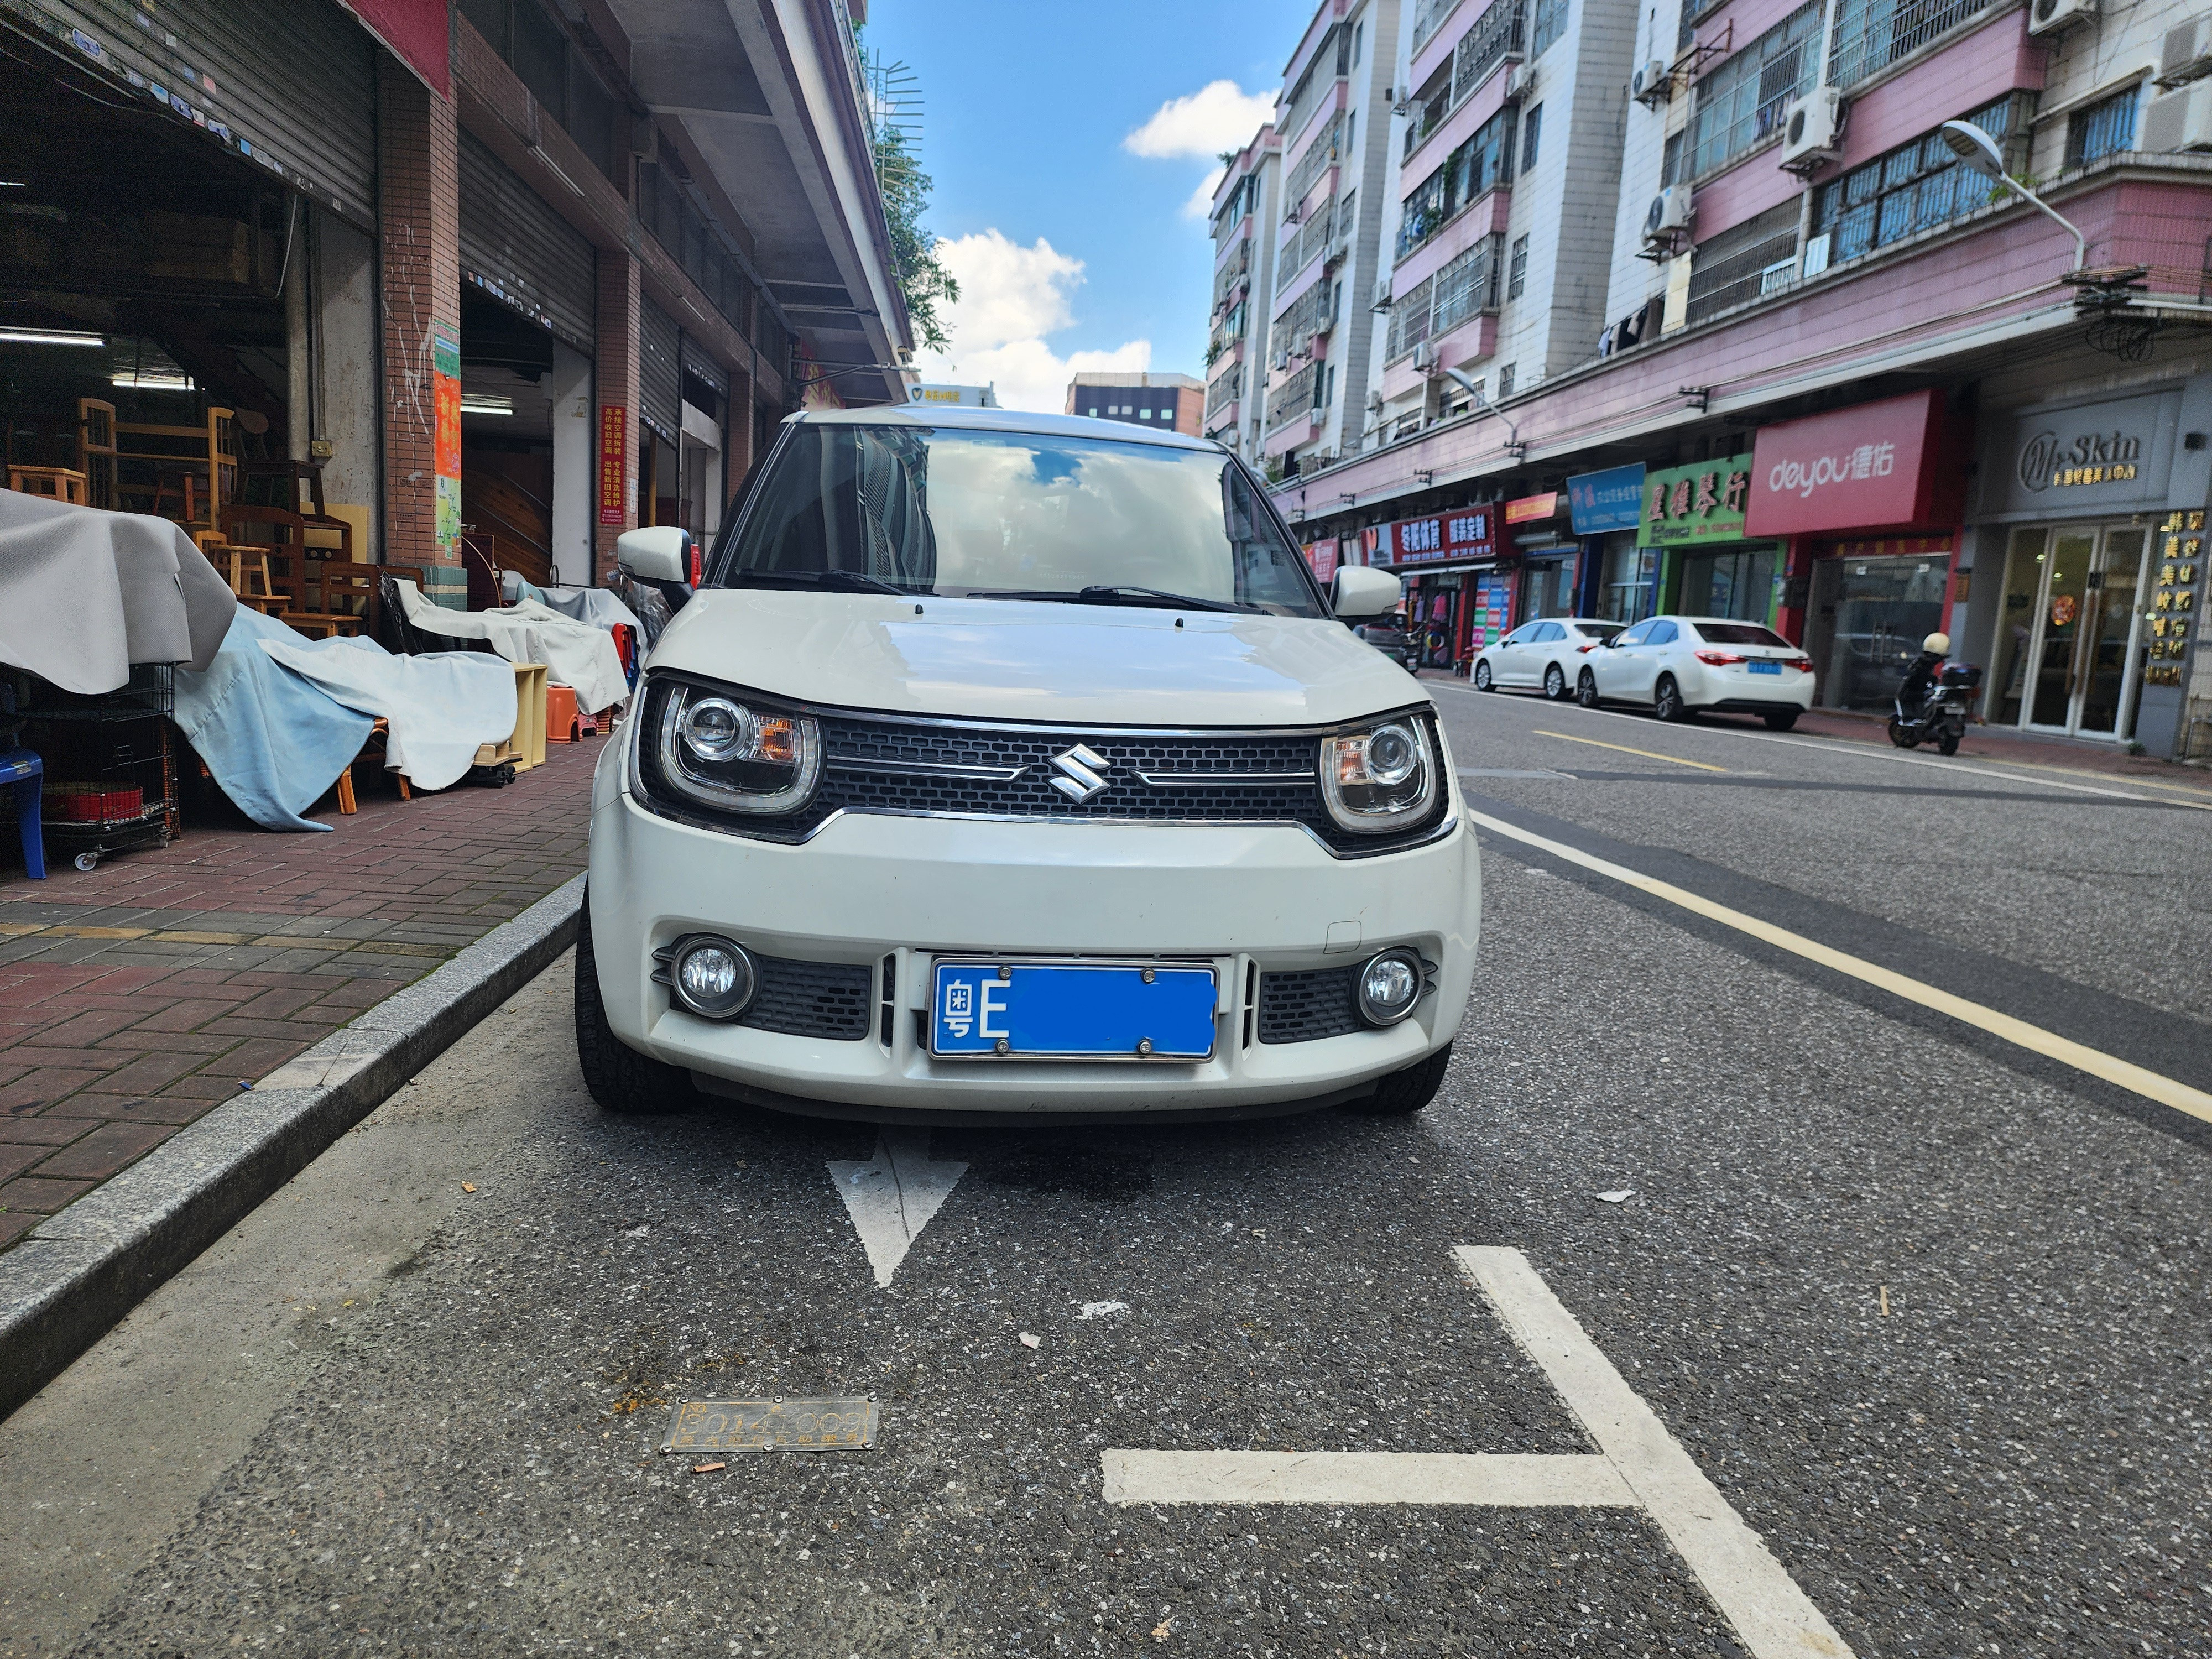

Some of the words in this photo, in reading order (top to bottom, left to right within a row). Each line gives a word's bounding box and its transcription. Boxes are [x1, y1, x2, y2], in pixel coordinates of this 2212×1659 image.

[604, 408, 613, 455] 高价收旧空调
[614, 408, 622, 455] 承接空调拆装
[2068, 430, 2140, 465] Skin
[1770, 455, 1851, 498] deyou
[1851, 439, 1895, 480] 德佑
[613, 461, 621, 507] 专业清洗维护
[1647, 471, 1745, 522] 星雅琴行
[1449, 513, 1485, 544] 服装定制
[681, 1413, 864, 1434] 30141009
